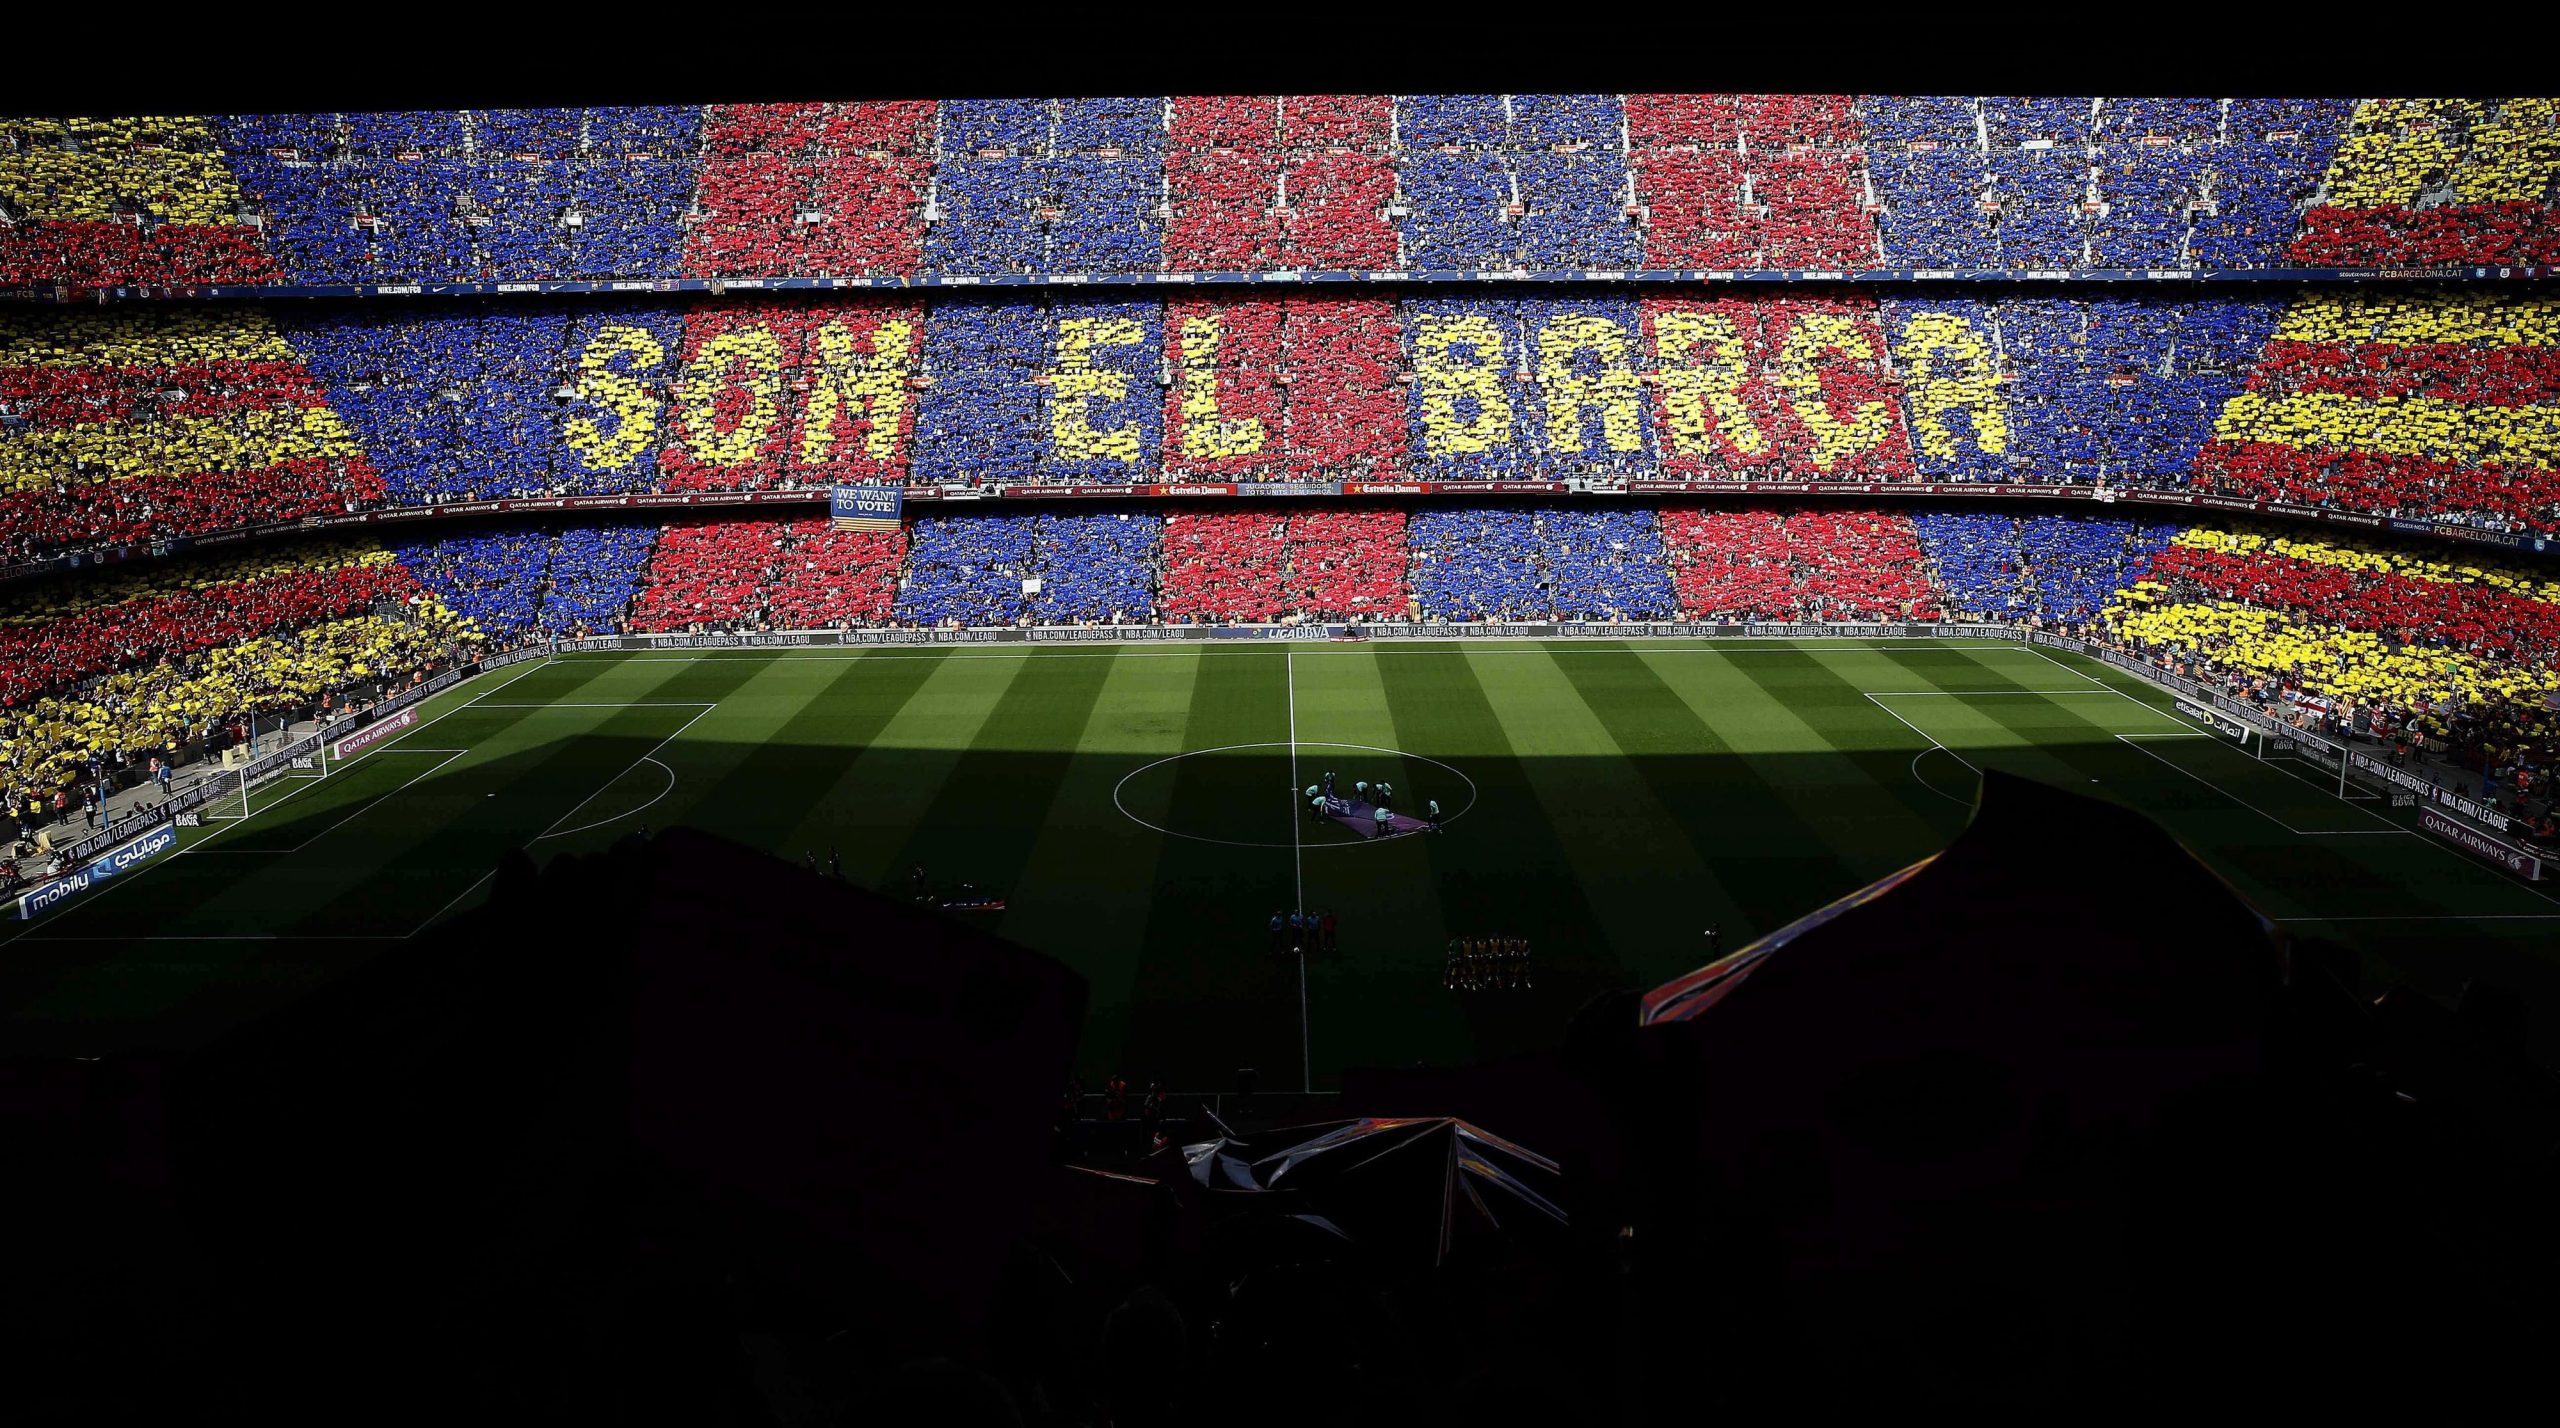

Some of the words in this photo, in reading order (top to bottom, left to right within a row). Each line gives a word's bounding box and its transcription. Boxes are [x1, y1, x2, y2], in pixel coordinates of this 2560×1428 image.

[1049, 275, 1087, 284] NIKE.COM/FCB
[1370, 272, 1408, 281] NIKE.COM/FCB
[1803, 272, 1842, 280] NIKE.COM/FCB
[1914, 271, 1954, 280] NIKE.COM/FCB
[2027, 271, 2069, 280] NIKE.COM/FCB
[2148, 271, 2192, 280] NIKE.COM/FCB
[2379, 270, 2462, 279] FCBARCELONA.CAT
[612, 281, 653, 291] NIKE.COM/FCB
[941, 277, 980, 286] NIKE.COM/FCB
[378, 285, 421, 295] NIKE.COM/FCB
[497, 283, 540, 293] NIKE.COM/FCB
[566, 319, 913, 470] SOM
[1051, 315, 1266, 461] EL
[1169, 485, 1200, 495] Estrella
[1201, 485, 1227, 495] Damm
[1362, 483, 1394, 494] Estrella
[1395, 484, 1421, 494] Damm
[837, 488, 857, 500] WE
[859, 489, 896, 502] WANT
[2137, 492, 2159, 500] QATAR
[530, 500, 555, 508] AIRWAYS
[595, 498, 618, 506] AIRWAYS
[836, 499, 853, 510] TO
[856, 500, 895, 512] VOTE!
[2225, 500, 2249, 508] AIRWAYS
[443, 506, 463, 514] QATAR
[464, 504, 490, 512] AIRWAYS
[2267, 505, 2287, 513] QATAR
[2288, 507, 2310, 516] AIRWAYS
[377, 512, 396, 520] QATAR
[398, 509, 425, 518] AIRWAYS
[2328, 513, 2347, 522] QATAR
[2348, 516, 2372, 526] AIRWAYS
[334, 516, 358, 524] AIRWAYS
[2434, 526, 2519, 547] FCBARCELONA.CAT
[1033, 630, 1113, 640] NBA.COM/LEAGUEPASS
[1268, 629, 1294, 639] LIGA
[1295, 626, 1329, 638] BBVA
[1377, 626, 1457, 636] NBA.COM/LEAGUEPASS
[1564, 626, 1645, 636] NBA.COM/LEAGUEPASS
[1751, 626, 1832, 636] NBA.COM/LEAGUEPASS
[1844, 626, 1907, 636] NBA.COM/LEAGUE
[1939, 627, 2022, 639] NBA.COM/LEAGUEPASS
[657, 637, 738, 648] NBA.COM/LEAGUEPASS
[846, 632, 926, 643] NBA.COM/LEAGUEPASS
[484, 646, 548, 669] NBA.COM/LEAGUEPASS
[2105, 651, 2155, 678] NBA.COM/LEAGUEPASS
[2176, 700, 2204, 721] etisalat
[2213, 718, 2240, 739] اتصالات
[344, 732, 370, 753] QATAR
[371, 718, 401, 739] AIRWAYS
[2355, 754, 2430, 796] NBA.COM/LEAGUEPASS
[2441, 791, 2509, 832] NBA.COM/LEAGUE
[76, 810, 158, 859] NBA.COM/LEAGUEPASS
[2425, 815, 2459, 839] QATAR
[2460, 832, 2505, 861] AIRWAYS
[114, 833, 170, 869] موبايلي
[32, 873, 89, 911] mobily
